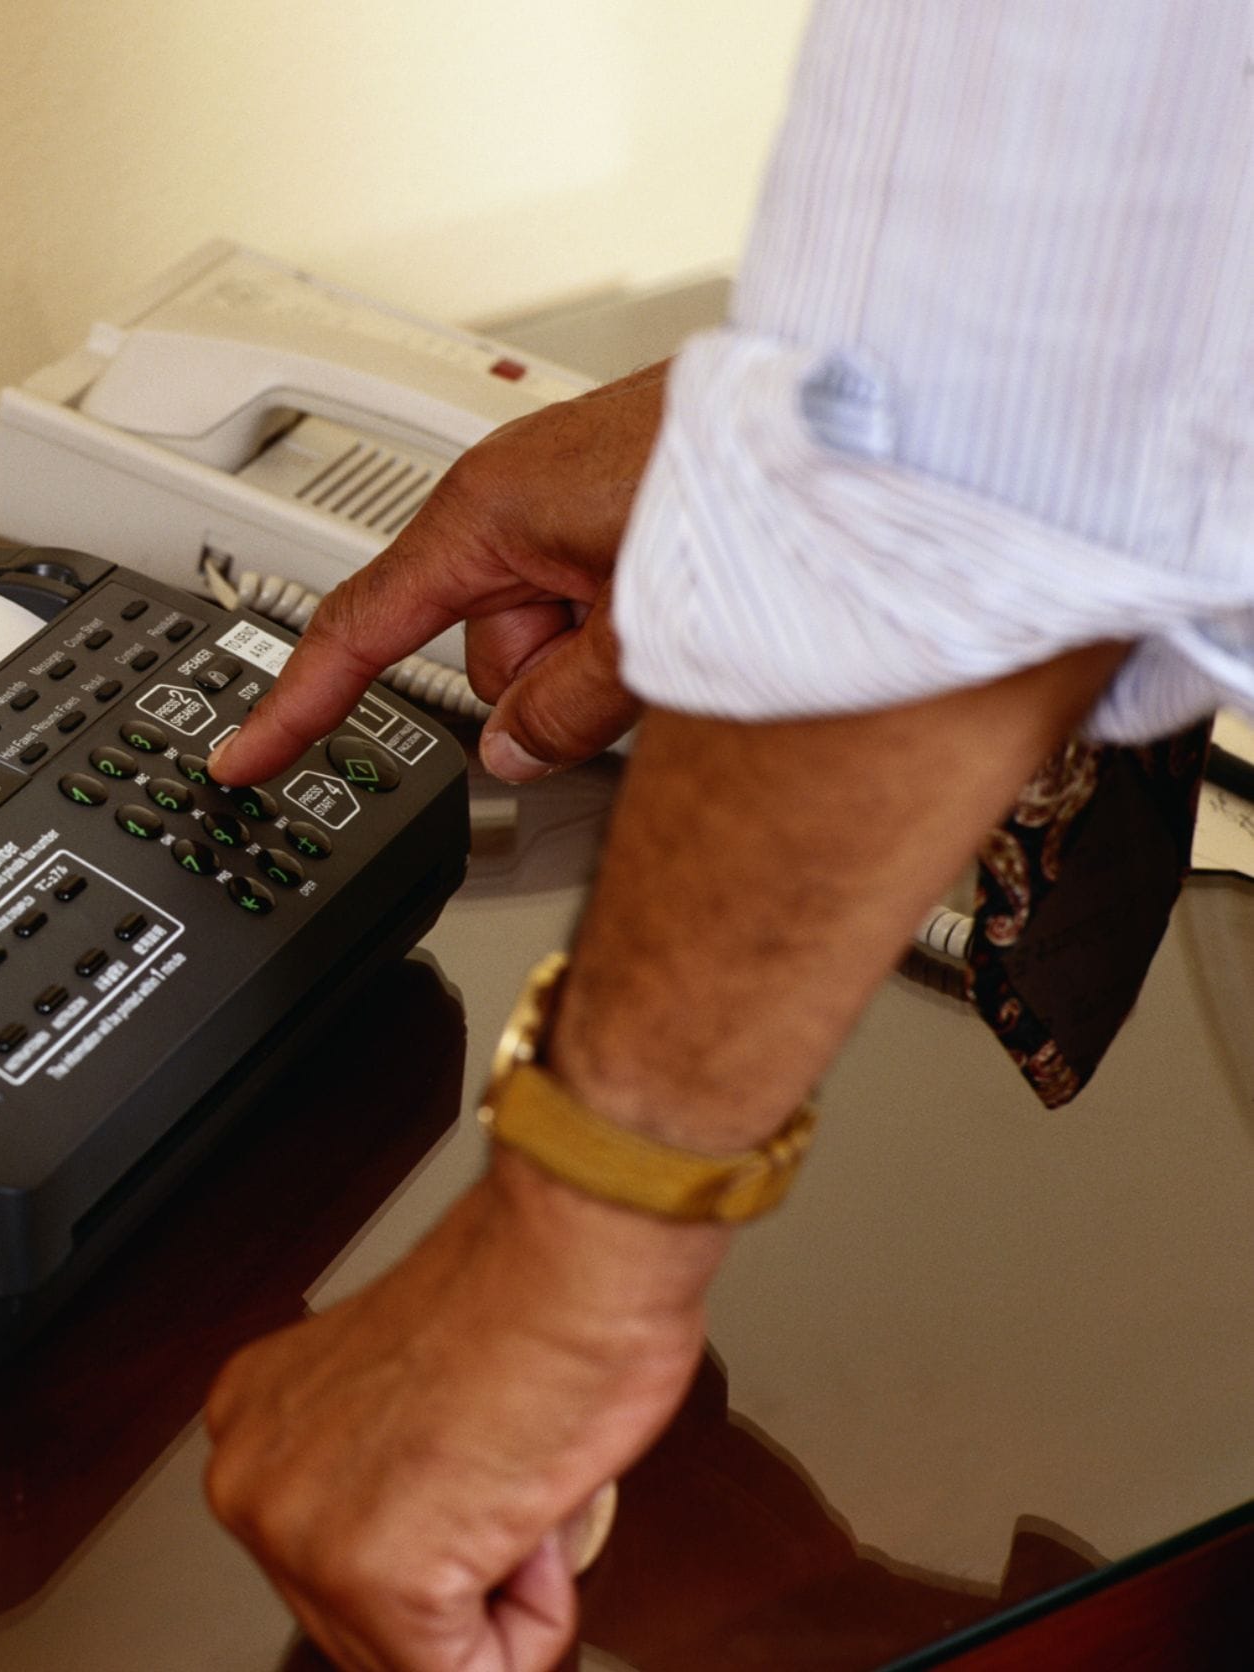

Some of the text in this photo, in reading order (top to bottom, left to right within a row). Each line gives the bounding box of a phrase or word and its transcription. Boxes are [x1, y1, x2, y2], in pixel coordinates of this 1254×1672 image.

[63, 617, 104, 648] Cover Sheet
[146, 610, 181, 638] Resolution
[224, 626, 258, 651] TO SEND
[114, 642, 145, 665] Contrast
[249, 640, 274, 658] A FAX
[28, 649, 66, 677] Messages
[177, 648, 215, 676] SPEAKER
[8, 679, 28, 695] Info
[80, 674, 106, 693] Redial
[237, 682, 262, 700] STOP
[154, 690, 192, 718] PRESS 2
[170, 700, 203, 727] SPEAKER
[357, 703, 385, 723] 1
[12, 730, 39, 748] Faxes
[30, 709, 63, 733] Resume
[54, 694, 81, 713] Faxes
[130, 734, 152, 750] 3
[134, 772, 151, 786] ABC
[72, 787, 92, 804] 1
[155, 791, 178, 810] 5
[298, 780, 344, 806] PRESS 4
[312, 795, 338, 817] START
[182, 855, 201, 872] 7
[299, 880, 318, 897] OPER
[148, 967, 166, 980] 1
